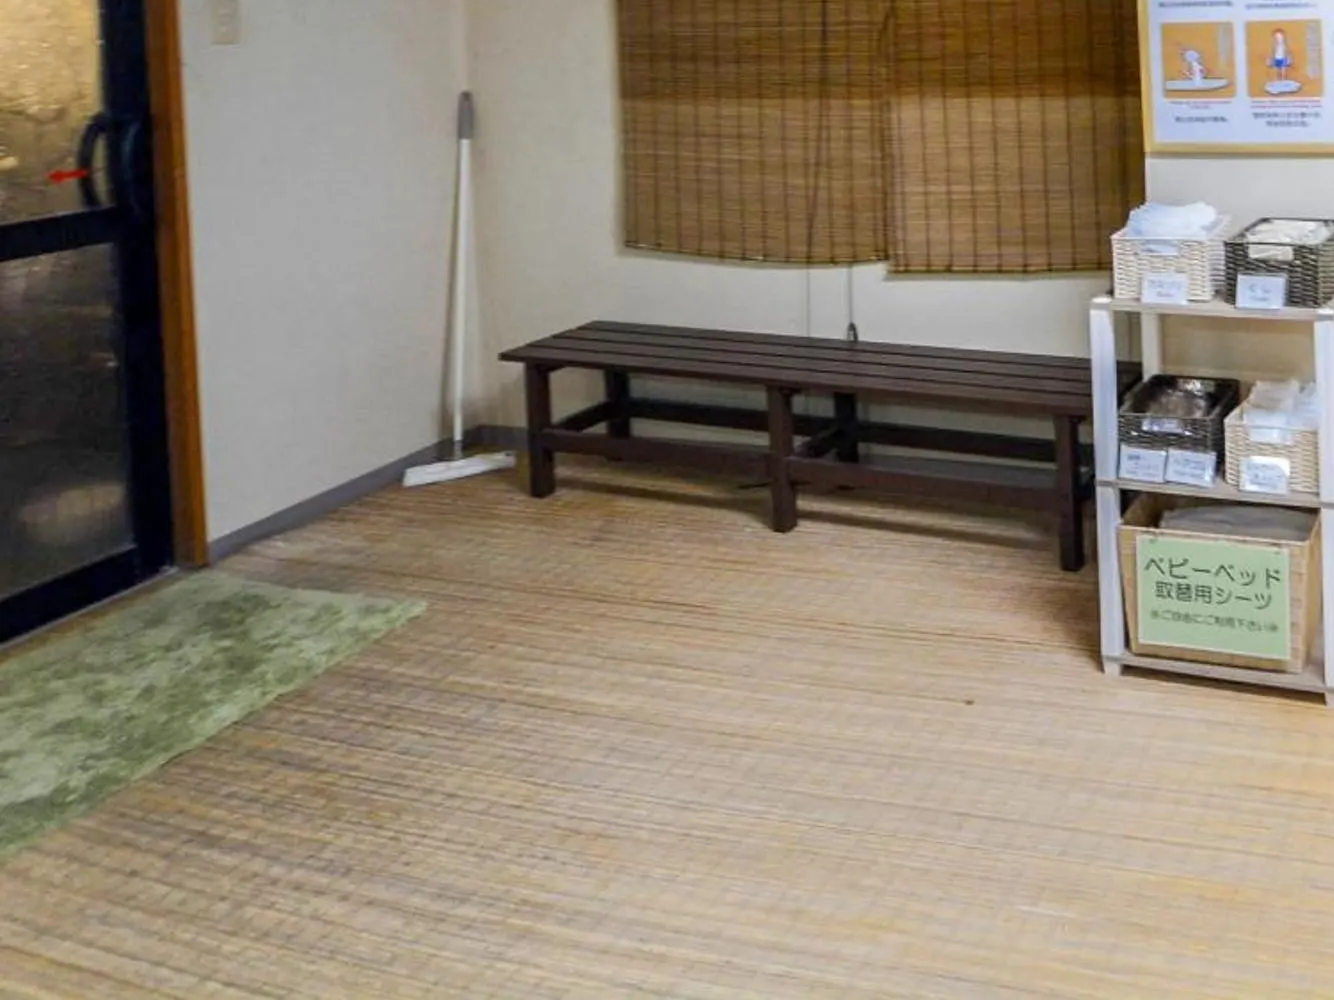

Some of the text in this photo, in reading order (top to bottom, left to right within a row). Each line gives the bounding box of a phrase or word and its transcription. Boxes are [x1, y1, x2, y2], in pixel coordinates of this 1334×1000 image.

[1144, 557, 1281, 589] ベビーベッド
[1155, 580, 1273, 610] 取替用シーツ
